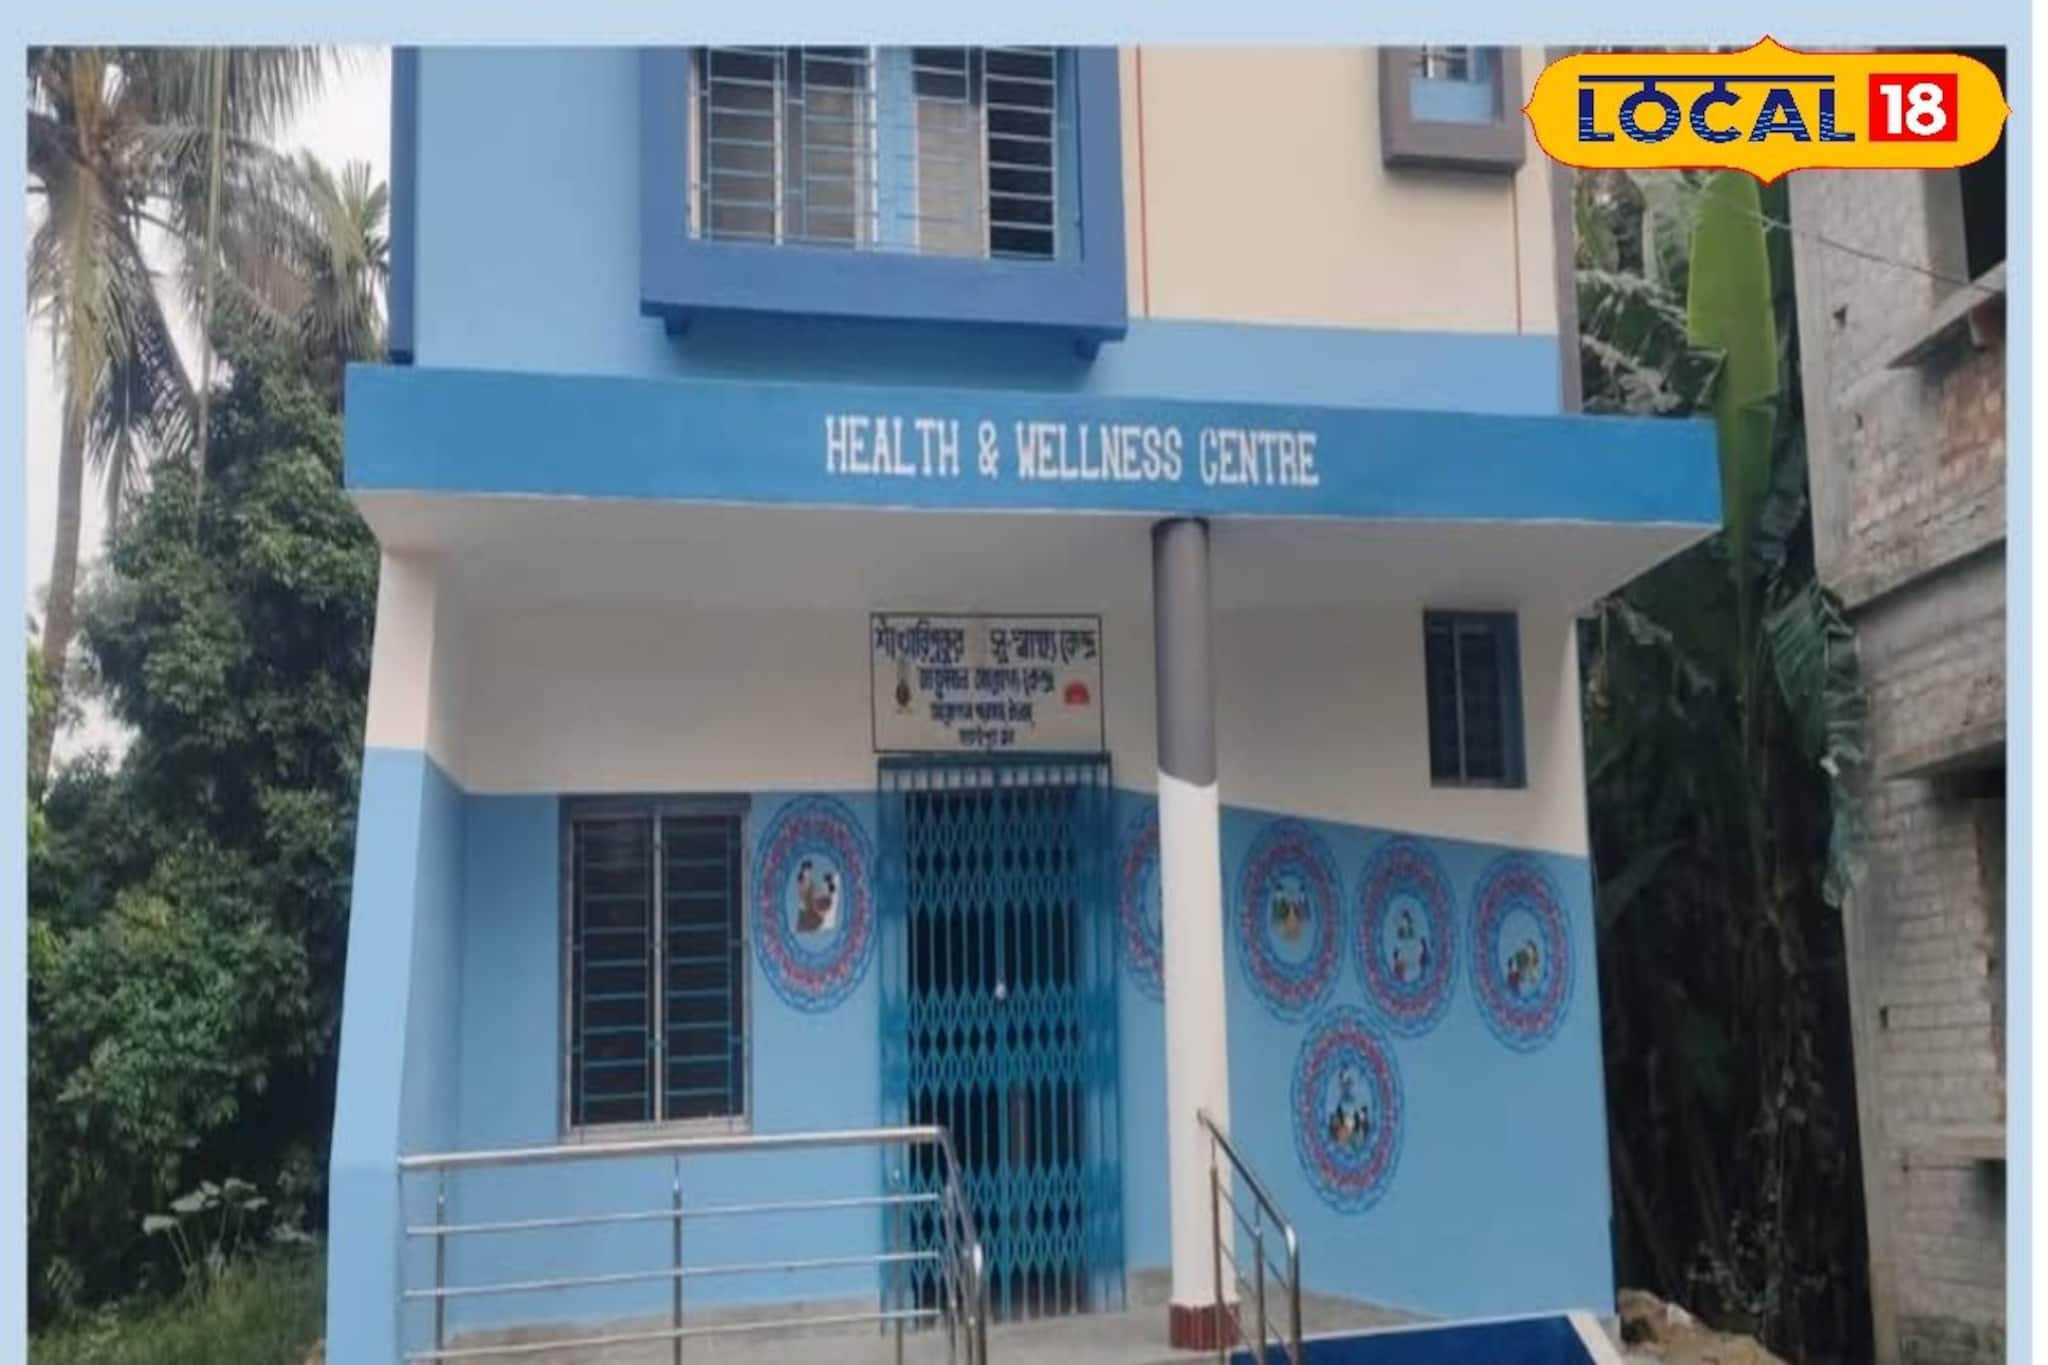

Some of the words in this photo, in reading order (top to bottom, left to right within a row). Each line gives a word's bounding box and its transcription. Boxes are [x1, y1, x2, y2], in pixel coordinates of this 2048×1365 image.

[825, 415, 960, 477] HEALTH
[978, 420, 999, 480] &
[1015, 421, 1182, 483] WELLNESS
[1200, 428, 1320, 487] CENTRE
